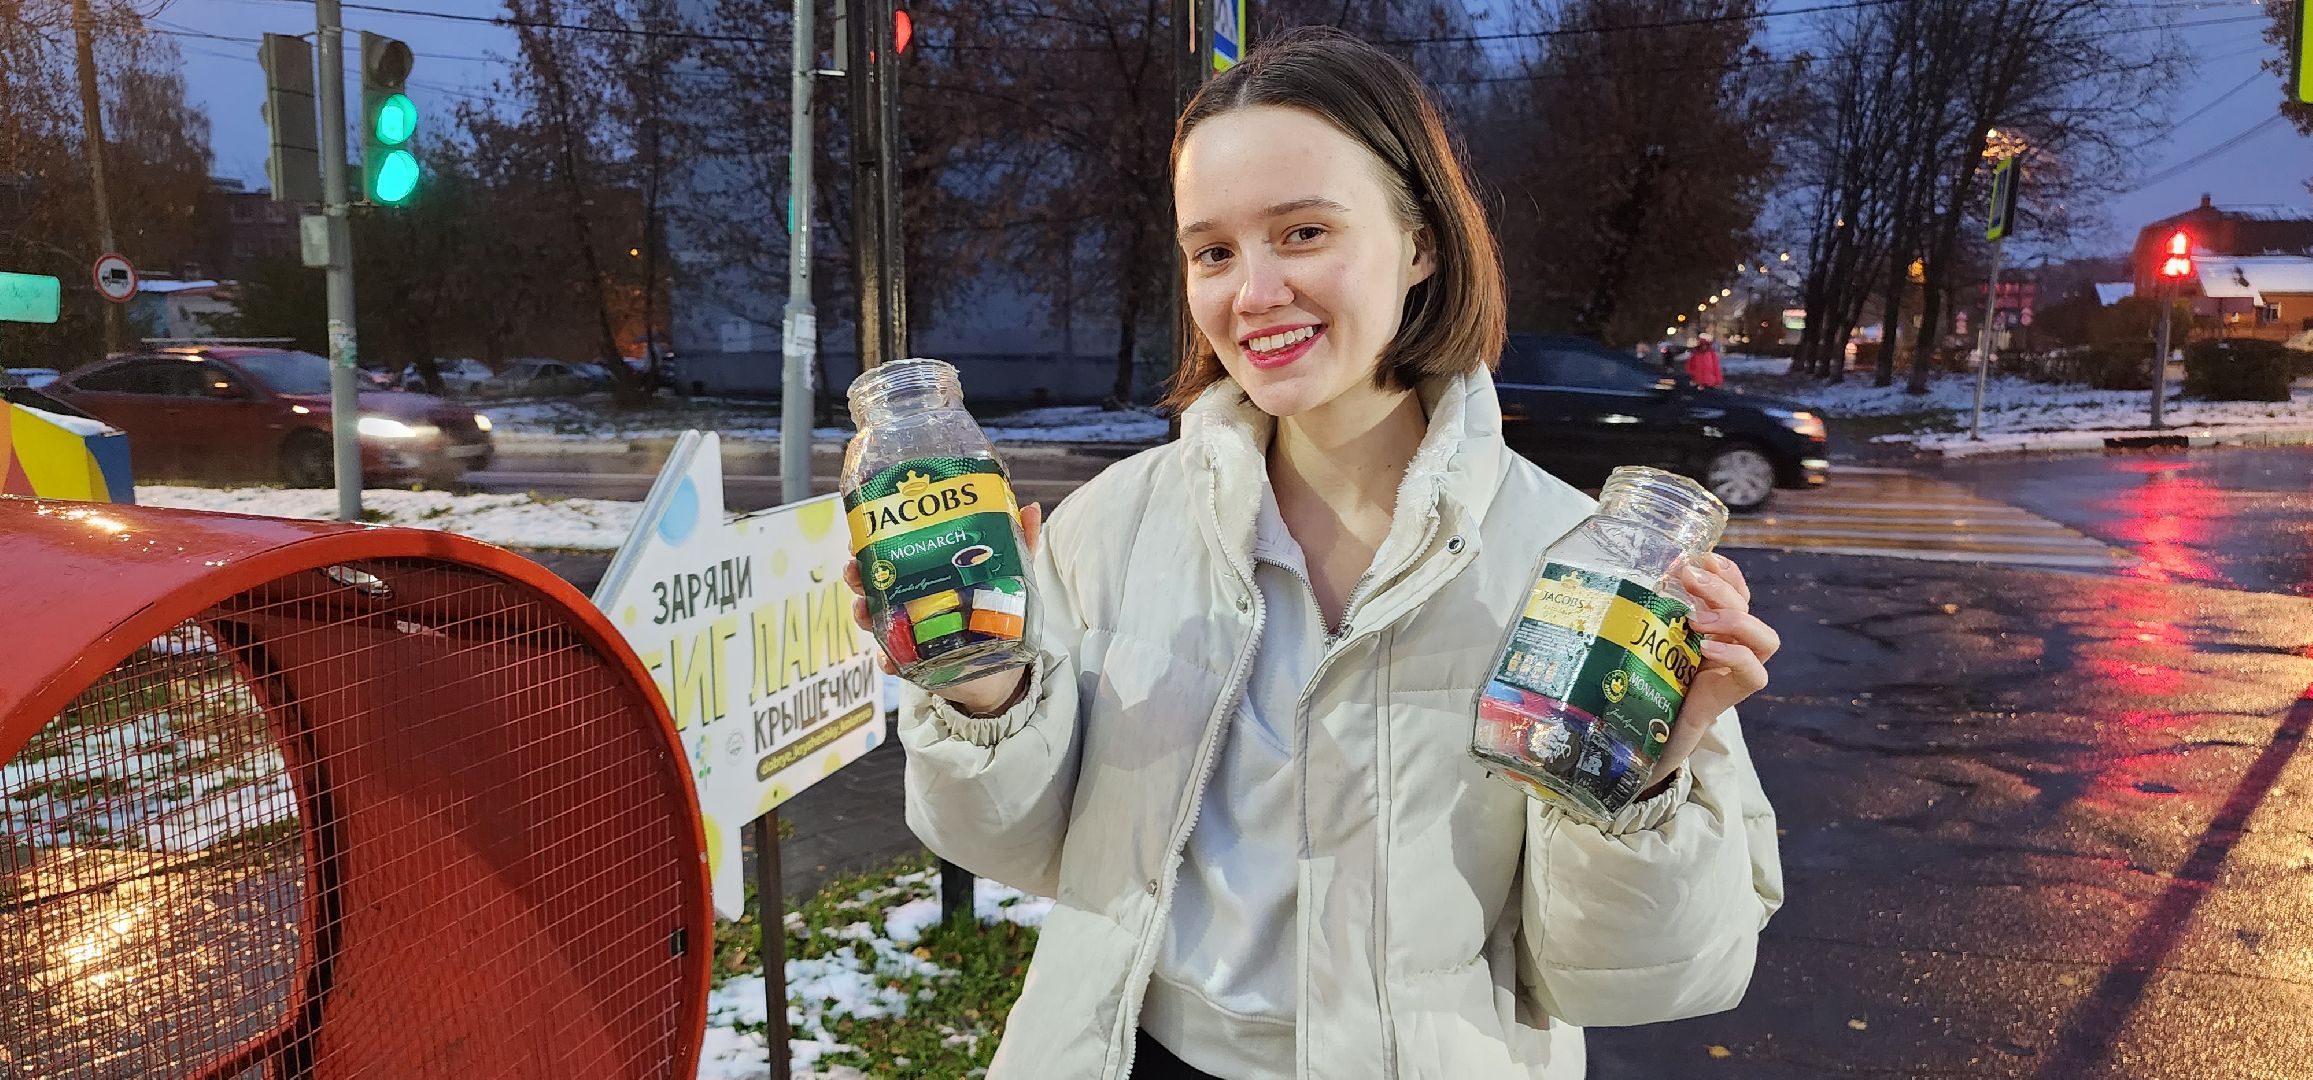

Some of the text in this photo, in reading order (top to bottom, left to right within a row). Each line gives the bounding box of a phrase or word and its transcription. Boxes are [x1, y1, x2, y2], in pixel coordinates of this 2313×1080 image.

[863, 482, 979, 538] JACOBS
[888, 529, 967, 562] MONARCH
[652, 554, 752, 625] ЗАРЯДИ
[1540, 590, 1585, 609] JACOBS
[1629, 619, 1697, 687] JACOBS
[753, 647, 875, 755] КРЫШЕЧКОЙ
[1628, 671, 1672, 713] MONARCH
